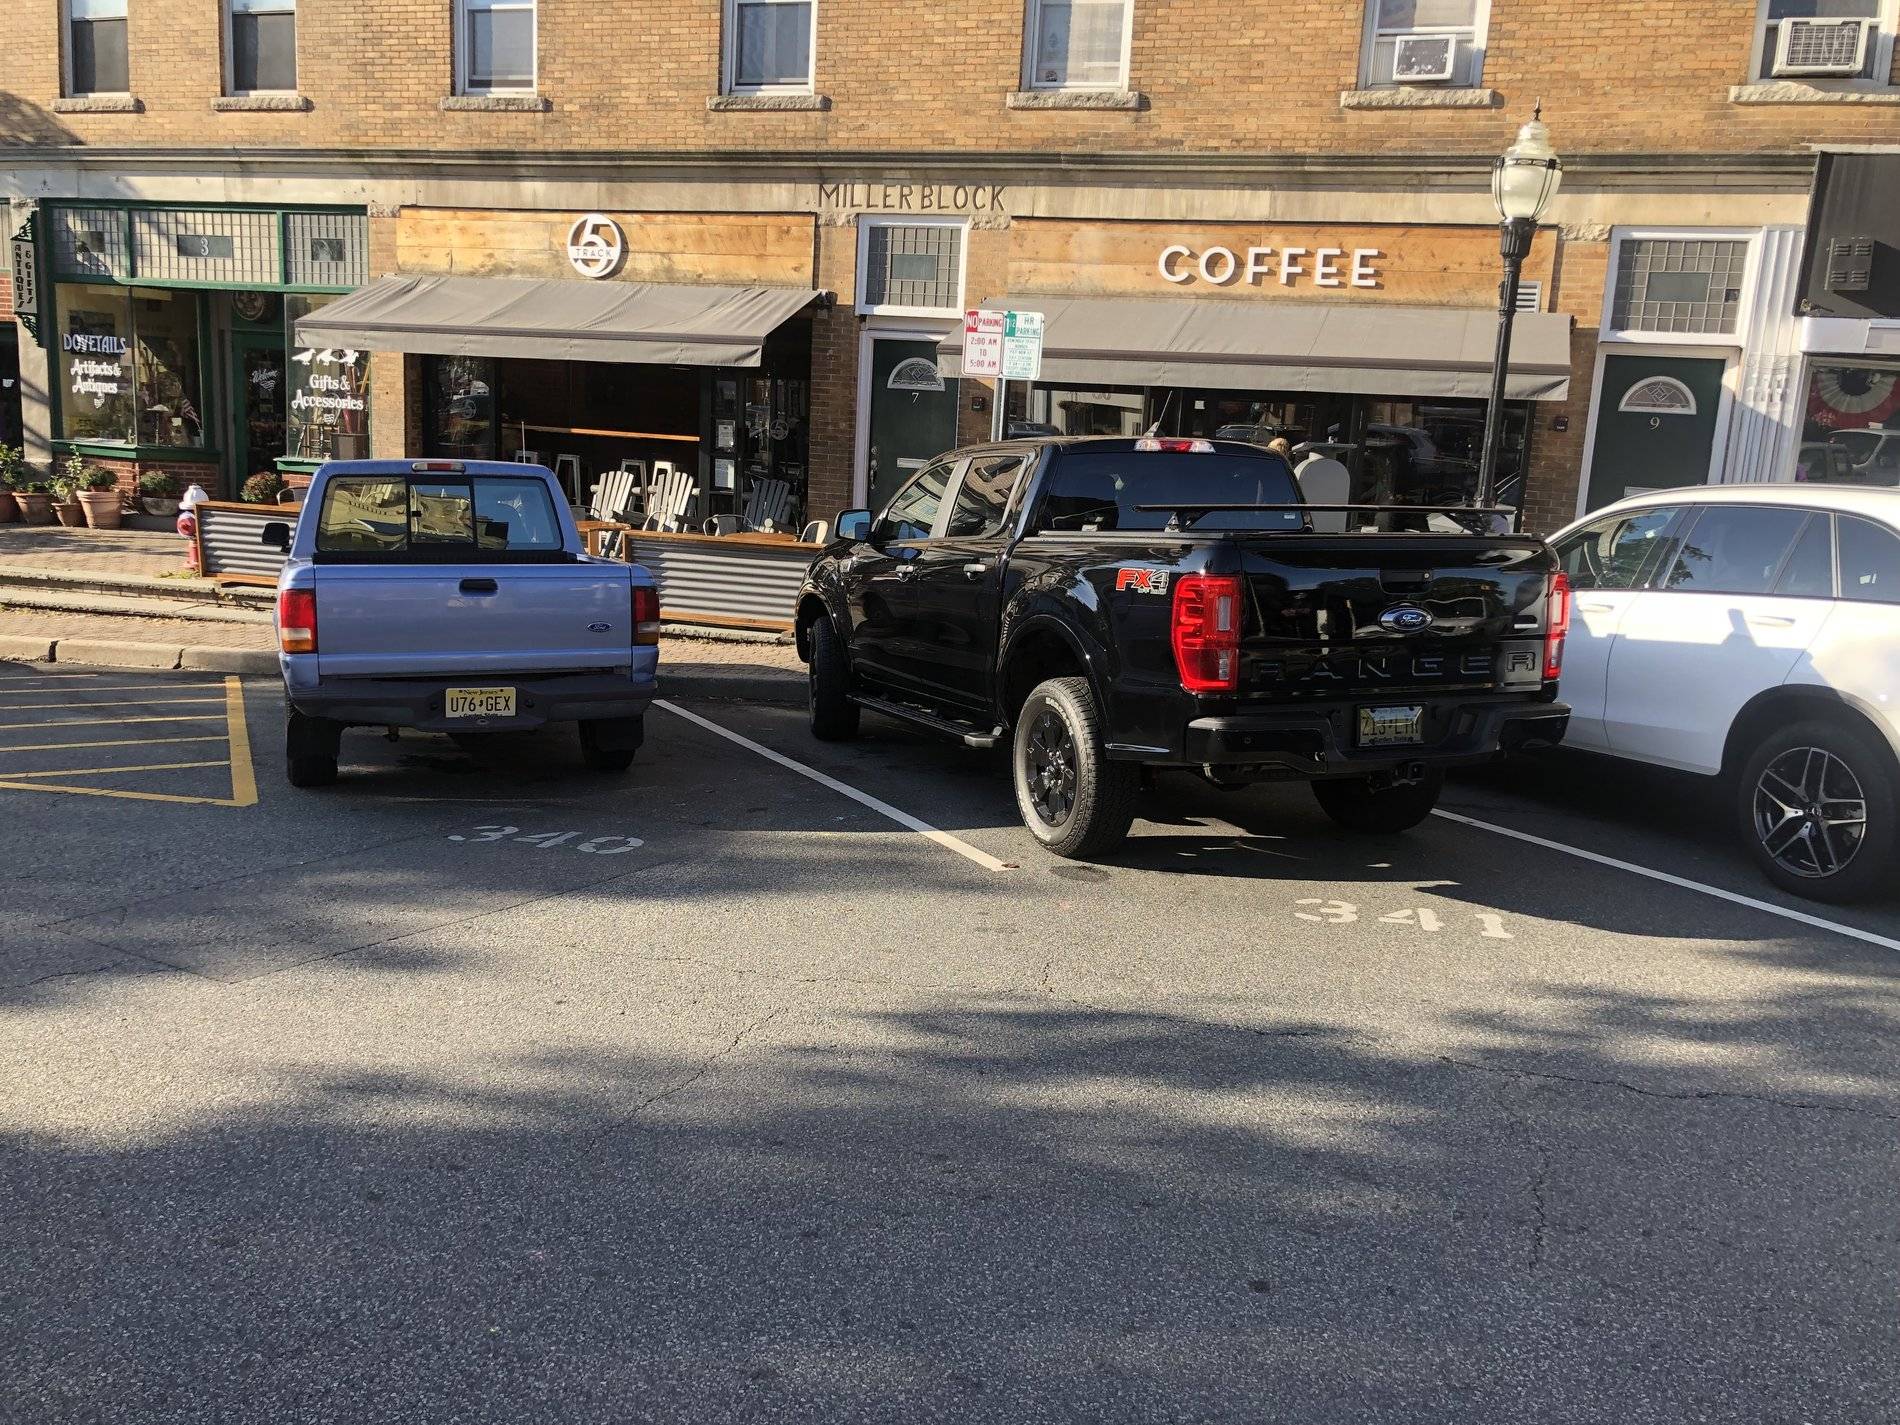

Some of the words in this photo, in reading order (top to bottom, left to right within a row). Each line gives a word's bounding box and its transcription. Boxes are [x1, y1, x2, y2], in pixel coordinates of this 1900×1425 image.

[818, 184, 913, 209] MILLER
[921, 185, 1005, 211] BLOCK
[200, 236, 209, 256] 3
[575, 248, 612, 258] TRACK
[577, 214, 611, 277] 5
[1158, 244, 1379, 287] COFFEE
[14, 244, 24, 308] ANTIQUES
[967, 314, 978, 328] NO
[978, 318, 1002, 328] PARKING
[1024, 316, 1035, 325] HR
[970, 337, 986, 346] 2:00
[988, 338, 998, 346] AM
[1016, 328, 1039, 336] PARKING
[63, 333, 126, 354] DOVETAILS
[70, 359, 114, 377] Artifacts
[970, 359, 985, 368] 5:00
[988, 360, 997, 368] AM
[72, 376, 118, 397] Antiques
[309, 374, 339, 391] Gifts
[340, 375, 351, 390] &
[291, 389, 364, 410] Accessories
[912, 392, 919, 404] 7
[1650, 416, 1660, 430] 9
[1115, 568, 1170, 591] FX4
[1251, 651, 1535, 680] RANGER
[450, 696, 476, 712] U76
[485, 695, 511, 712] GEX
[447, 825, 645, 855] 340
[1294, 898, 1516, 939] 341
